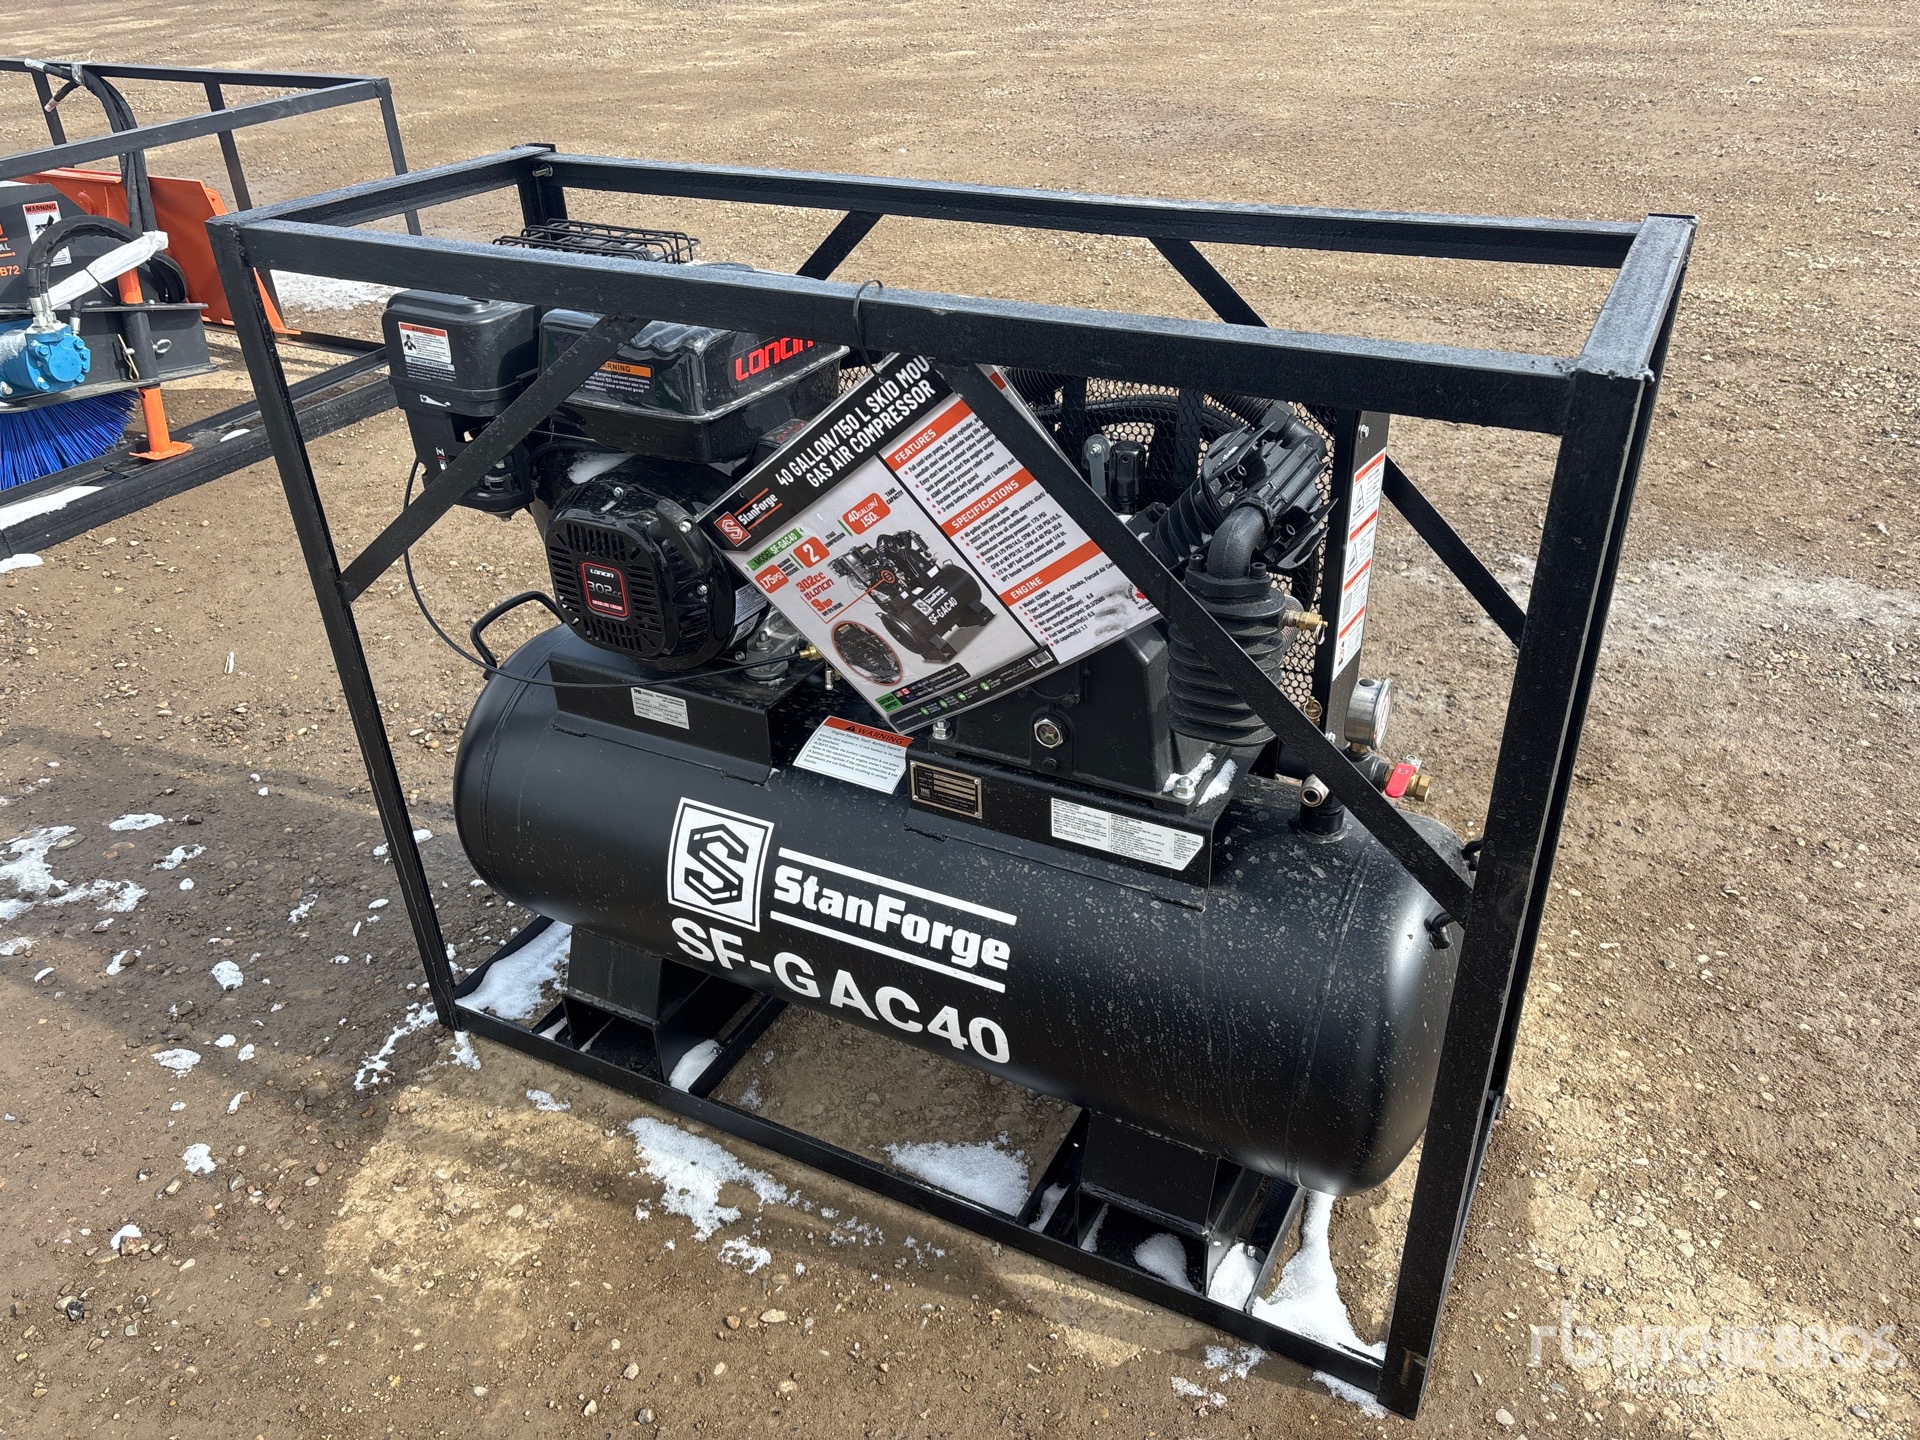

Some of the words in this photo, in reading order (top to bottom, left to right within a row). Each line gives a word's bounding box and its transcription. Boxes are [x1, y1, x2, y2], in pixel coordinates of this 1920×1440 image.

[25, 204, 56, 212] WARNING
[602, 362, 631, 372] ARNING
[775, 468, 794, 486] 40
[788, 413, 860, 476] GALLON/150
[856, 406, 871, 422] L
[865, 380, 900, 413] SKID
[896, 355, 930, 388] MOU
[806, 462, 833, 487] GAS
[829, 445, 854, 471] AIR
[849, 379, 936, 453] COMPRESSOR
[957, 421, 976, 436] cylinder,
[894, 428, 936, 463] FEATURES
[949, 439, 965, 453] provide
[963, 432, 975, 442] long
[972, 427, 981, 435] life
[965, 442, 977, 452] valve
[924, 484, 935, 492] tank
[933, 472, 950, 487] pressure
[953, 462, 964, 472] start
[969, 448, 984, 460] engine
[982, 439, 995, 451] under
[941, 477, 957, 491] certified
[956, 466, 974, 481] pressure
[972, 457, 984, 469] relief
[982, 451, 994, 461] valve
[884, 487, 896, 497] TANK
[935, 493, 951, 506] Durable
[950, 486, 960, 496] steel
[958, 481, 968, 489] belt
[966, 472, 979, 485] guard
[952, 492, 968, 504] battery
[966, 480, 985, 495] charging
[982, 474, 992, 483] unit
[992, 463, 1009, 476] battery
[1007, 457, 1016, 466] not
[737, 494, 778, 525] StanForge
[886, 490, 904, 505] CAPACITY
[951, 479, 1019, 529] SPECIFICATIONS
[980, 511, 1000, 527] horizontal
[998, 506, 1009, 514] tank
[988, 523, 998, 532] EPA
[996, 515, 1011, 527] engine
[1009, 509, 1020, 518] with
[1018, 499, 1035, 512] electric
[974, 539, 990, 551] backup
[988, 534, 997, 542] and
[1008, 514, 1028, 529] shutdown
[979, 543, 999, 557] Maximum
[997, 533, 1015, 546] working
[1044, 537, 1054, 546] and
[753, 549, 775, 566] MODEL
[769, 532, 798, 554] SF-GAC40
[802, 543, 820, 563] 2
[590, 568, 614, 578] LONCIN
[587, 580, 622, 598] 302cc
[925, 587, 946, 604] StanForge
[1010, 576, 1043, 599] ENGINE
[1037, 599, 1051, 608] Single
[1083, 569, 1100, 581] Forced
[928, 597, 958, 625] SF-GAC40
[858, 727, 904, 745] WARNING
[871, 740, 886, 748] Battery
[772, 866, 1012, 972] StanForge
